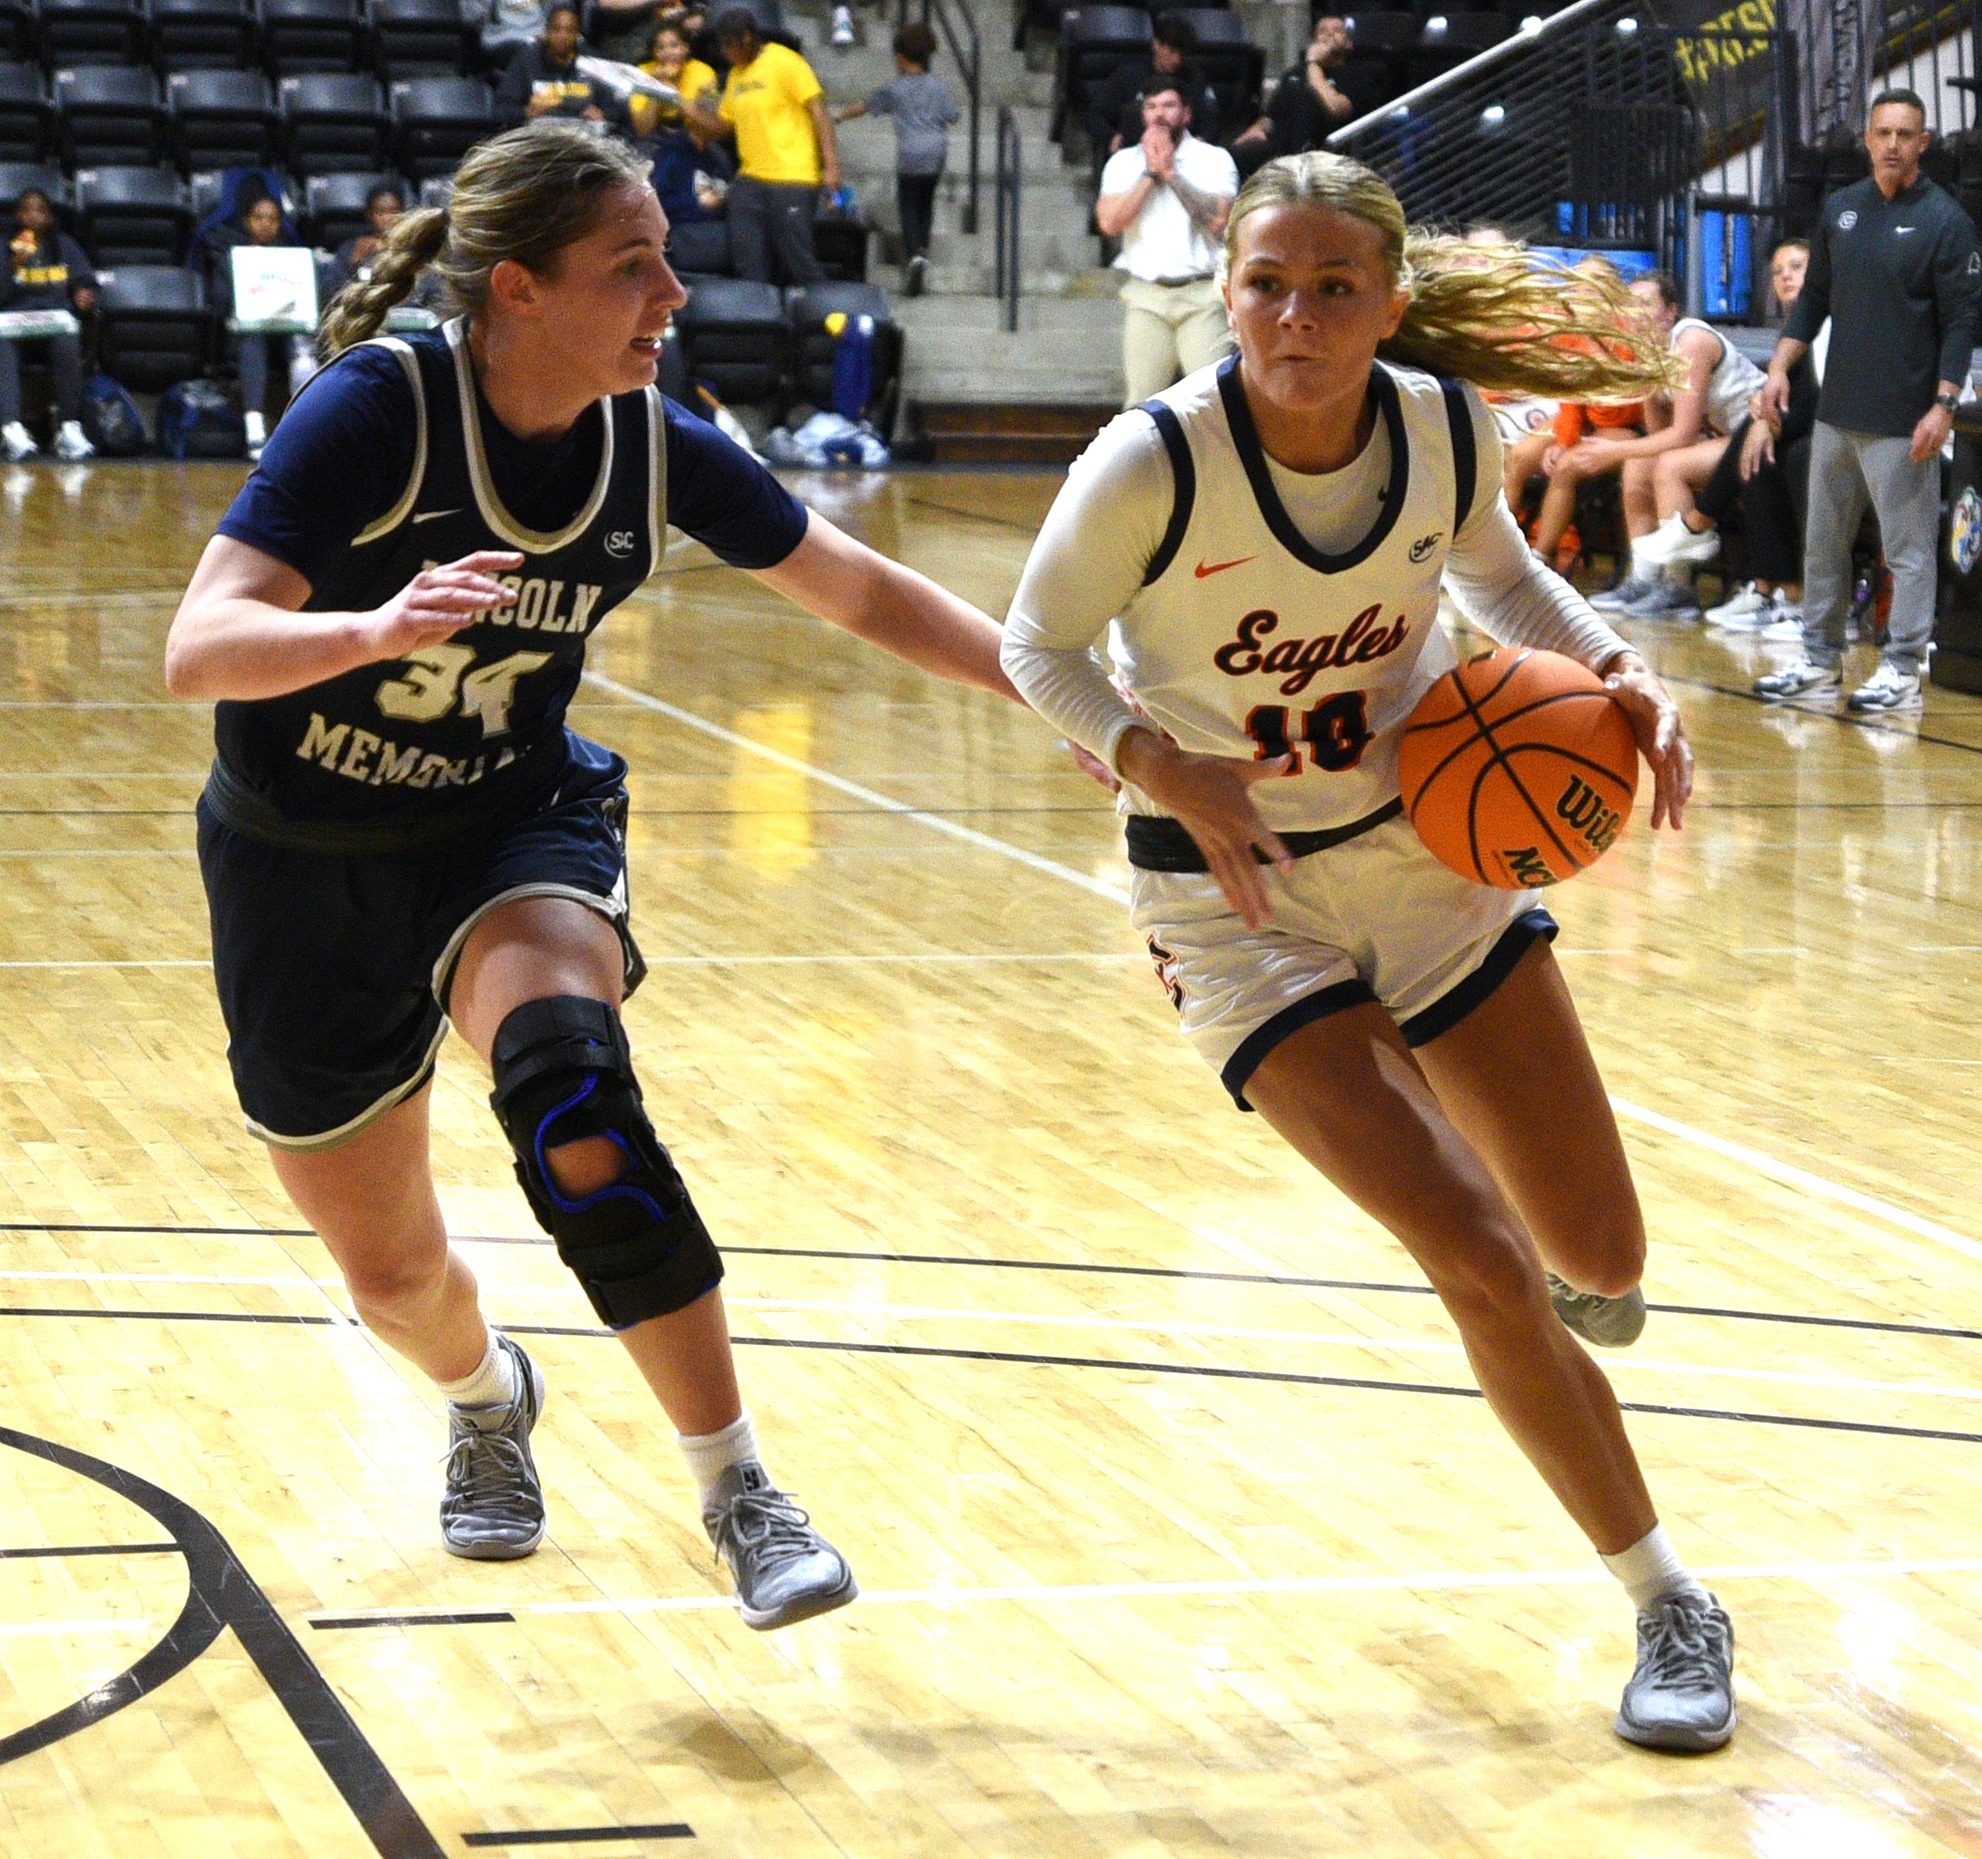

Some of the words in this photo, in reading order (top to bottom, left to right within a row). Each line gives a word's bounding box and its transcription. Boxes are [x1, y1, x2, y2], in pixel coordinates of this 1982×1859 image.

[1413, 532, 1444, 558] SAC
[374, 642, 555, 739] 34
[1214, 603, 1410, 695] Eagles
[1245, 689, 1376, 776] 10
